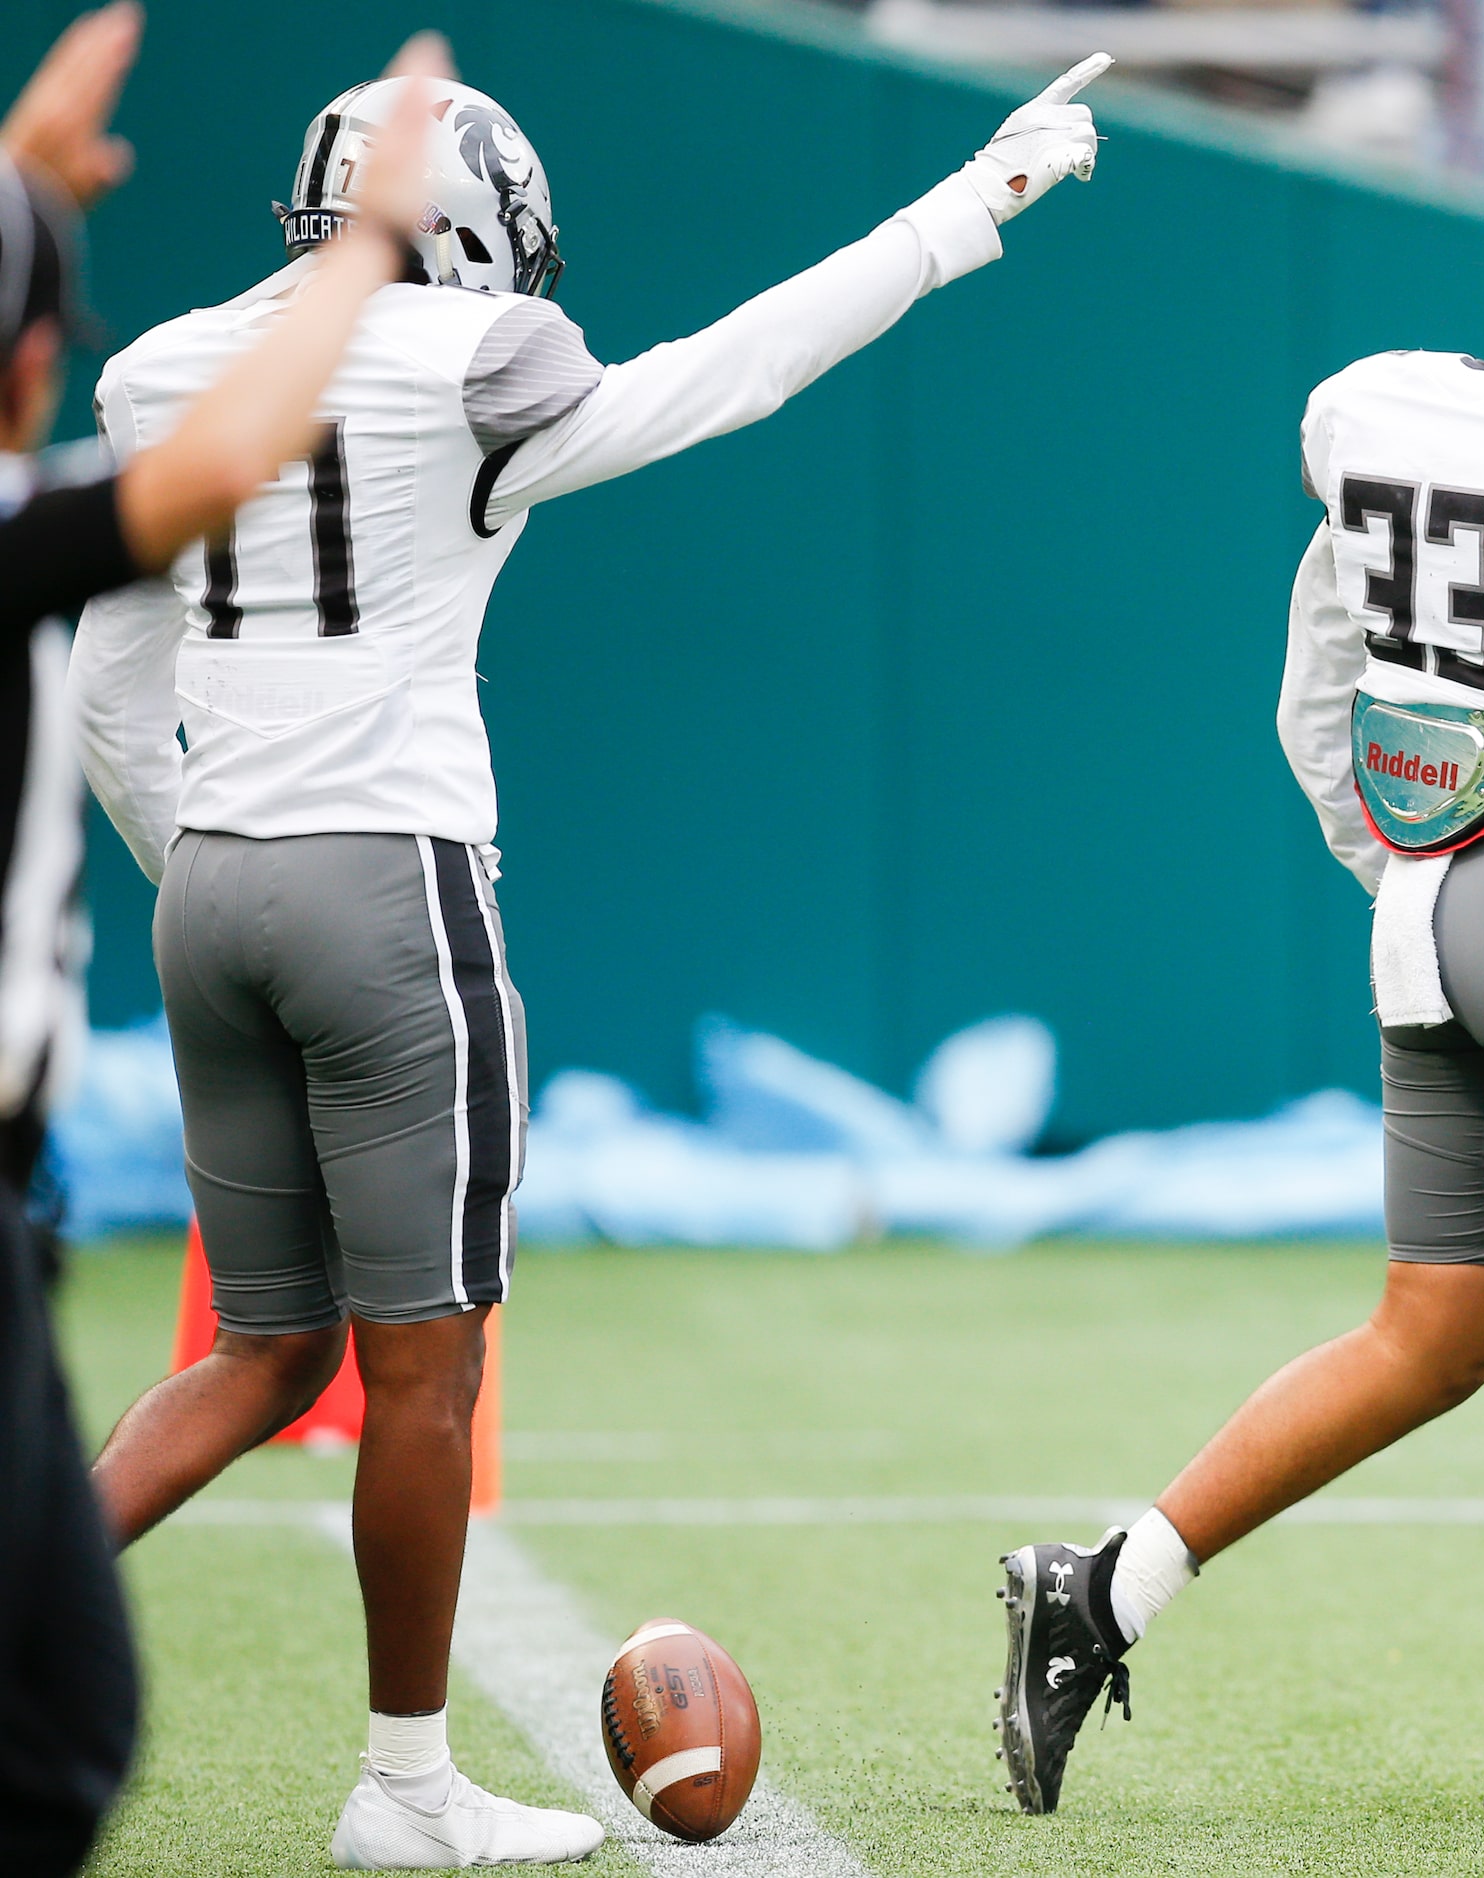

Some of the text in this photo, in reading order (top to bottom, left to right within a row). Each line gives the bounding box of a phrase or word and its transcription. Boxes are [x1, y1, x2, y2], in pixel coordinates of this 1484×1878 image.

[1366, 741, 1459, 791] Riddell
[632, 1659, 660, 1741] Wilson
[663, 1664, 689, 1709] GST
